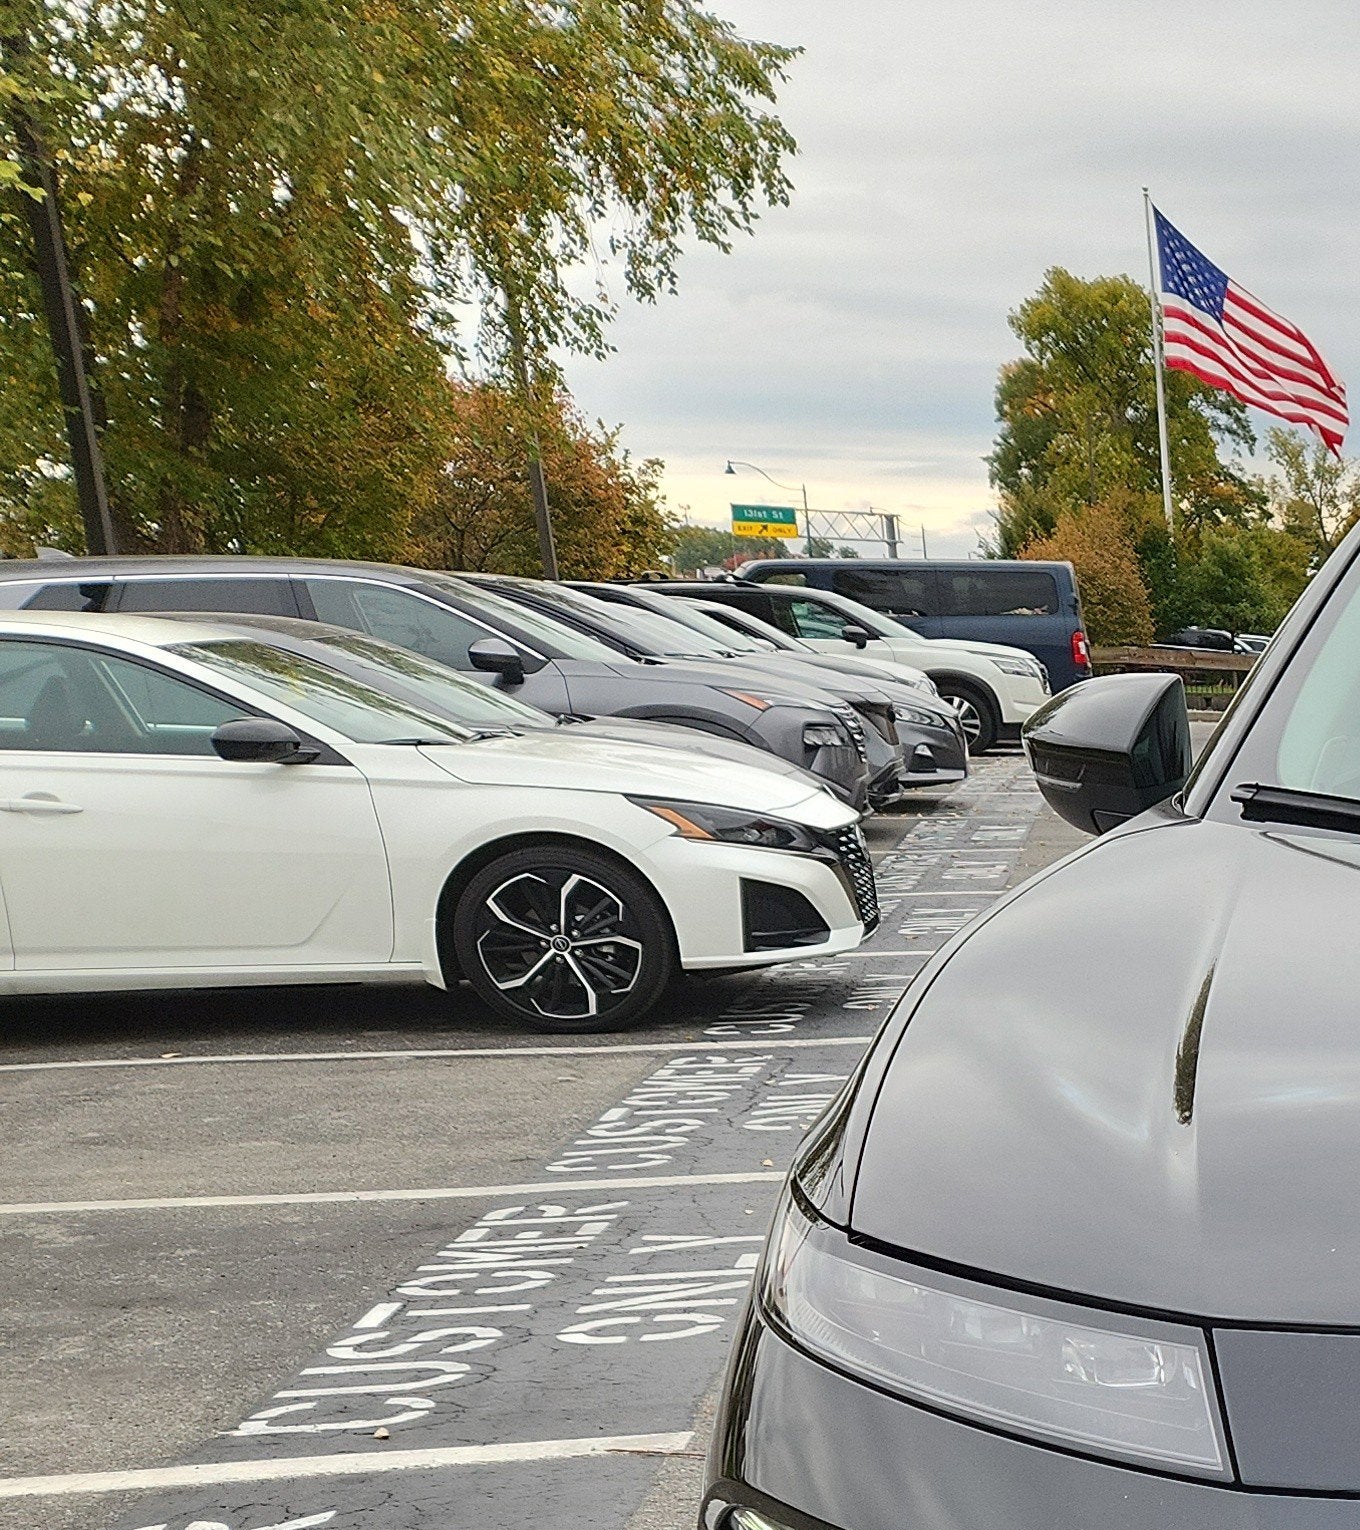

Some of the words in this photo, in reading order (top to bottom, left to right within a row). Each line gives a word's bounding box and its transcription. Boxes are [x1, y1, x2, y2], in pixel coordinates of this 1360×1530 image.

[744, 509, 767, 519] 131st
[772, 511, 784, 520] St
[545, 1055, 774, 1172] CUSTOMER
[217, 1201, 629, 1436] CUSTOMER
[556, 1234, 767, 1344] ONLY
